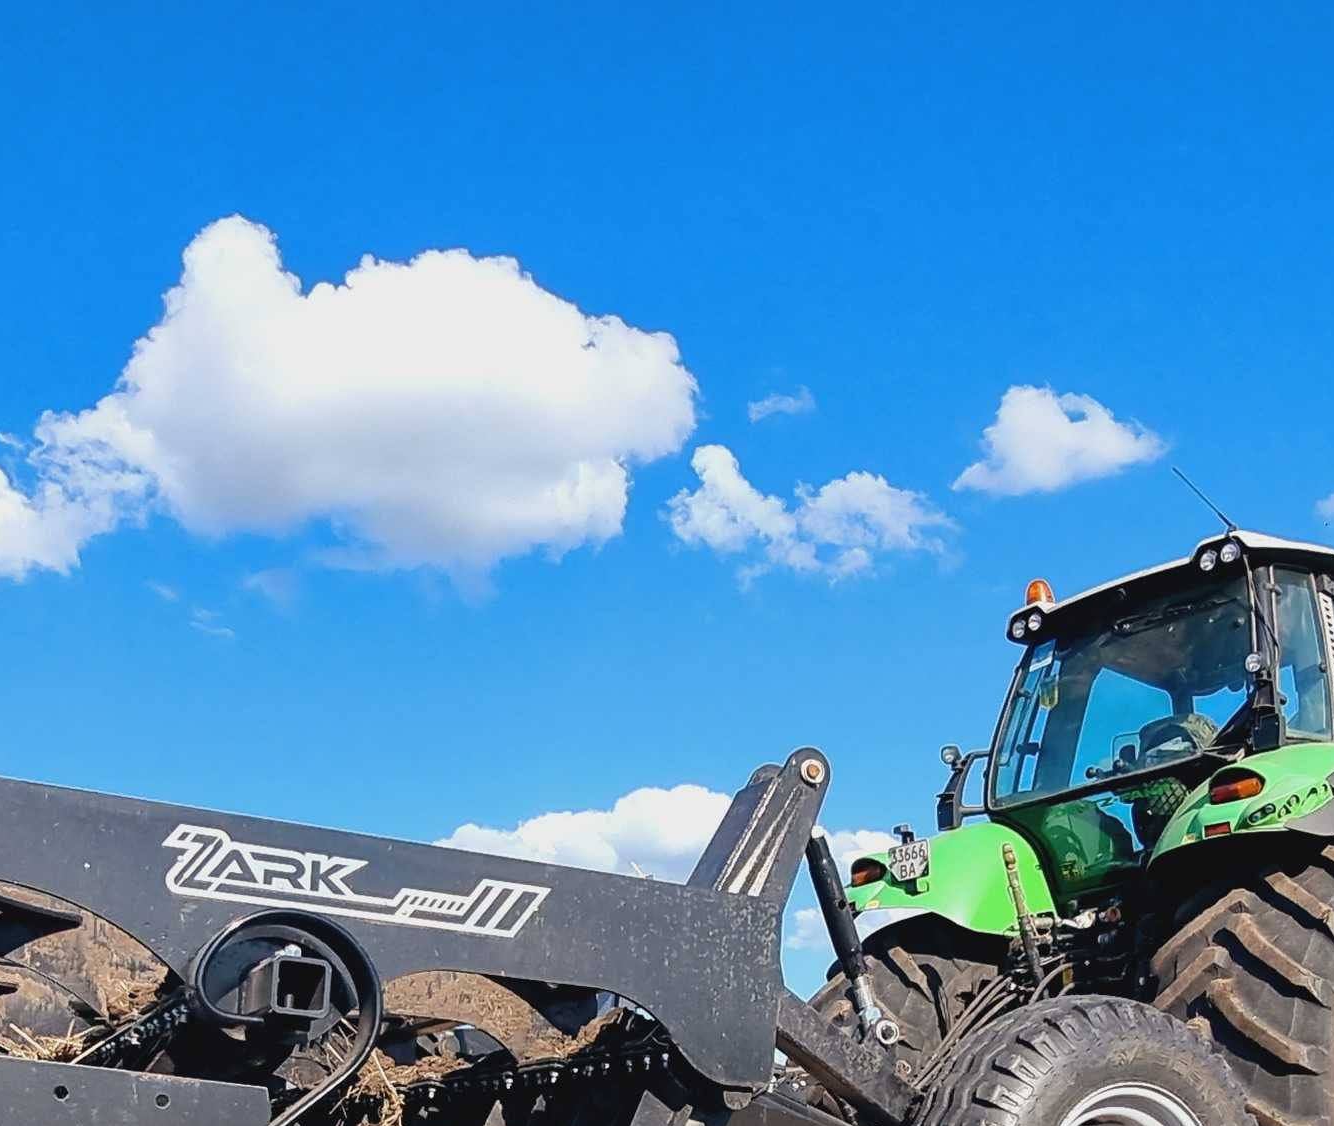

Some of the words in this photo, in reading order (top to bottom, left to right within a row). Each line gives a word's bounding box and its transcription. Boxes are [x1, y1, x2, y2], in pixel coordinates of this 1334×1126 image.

[162, 823, 369, 897] ZARK
[891, 843, 925, 865] 33666
[901, 862, 916, 878] BA
